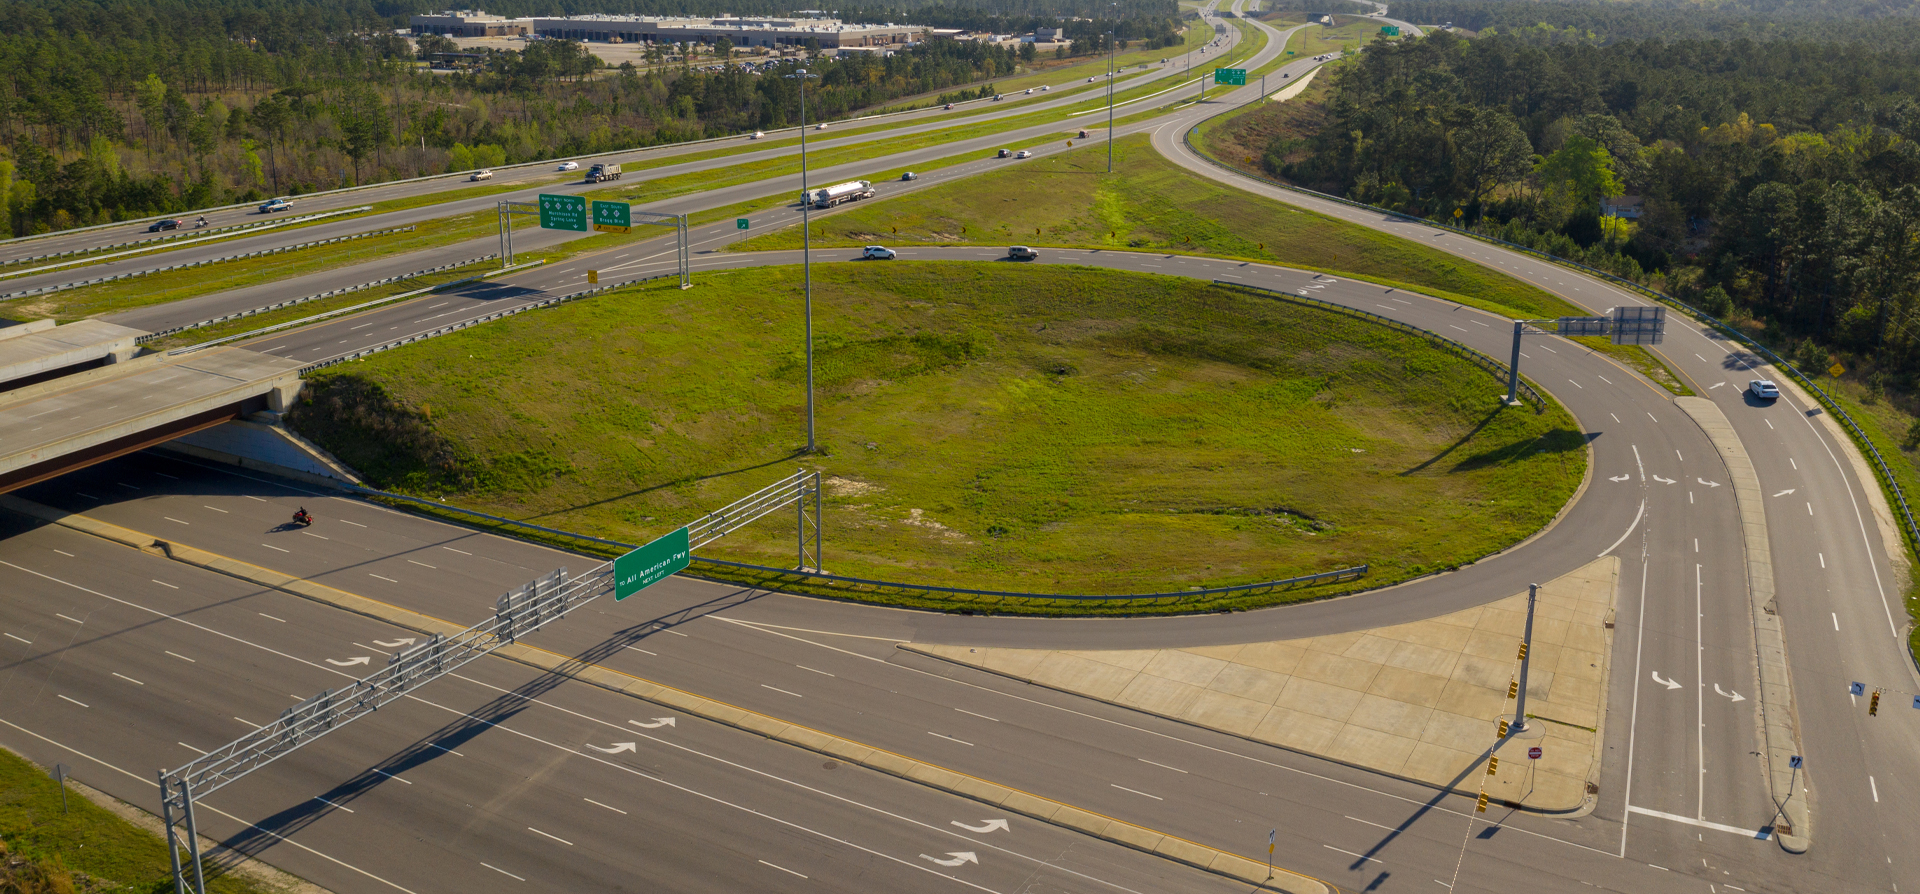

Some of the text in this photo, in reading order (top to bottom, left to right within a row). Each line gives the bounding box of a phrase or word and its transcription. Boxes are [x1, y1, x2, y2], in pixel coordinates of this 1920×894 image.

[626, 574, 636, 584] All
[640, 558, 670, 578] American
[672, 550, 686, 562] Fwy
[642, 570, 664, 584] NEXT LEFT
